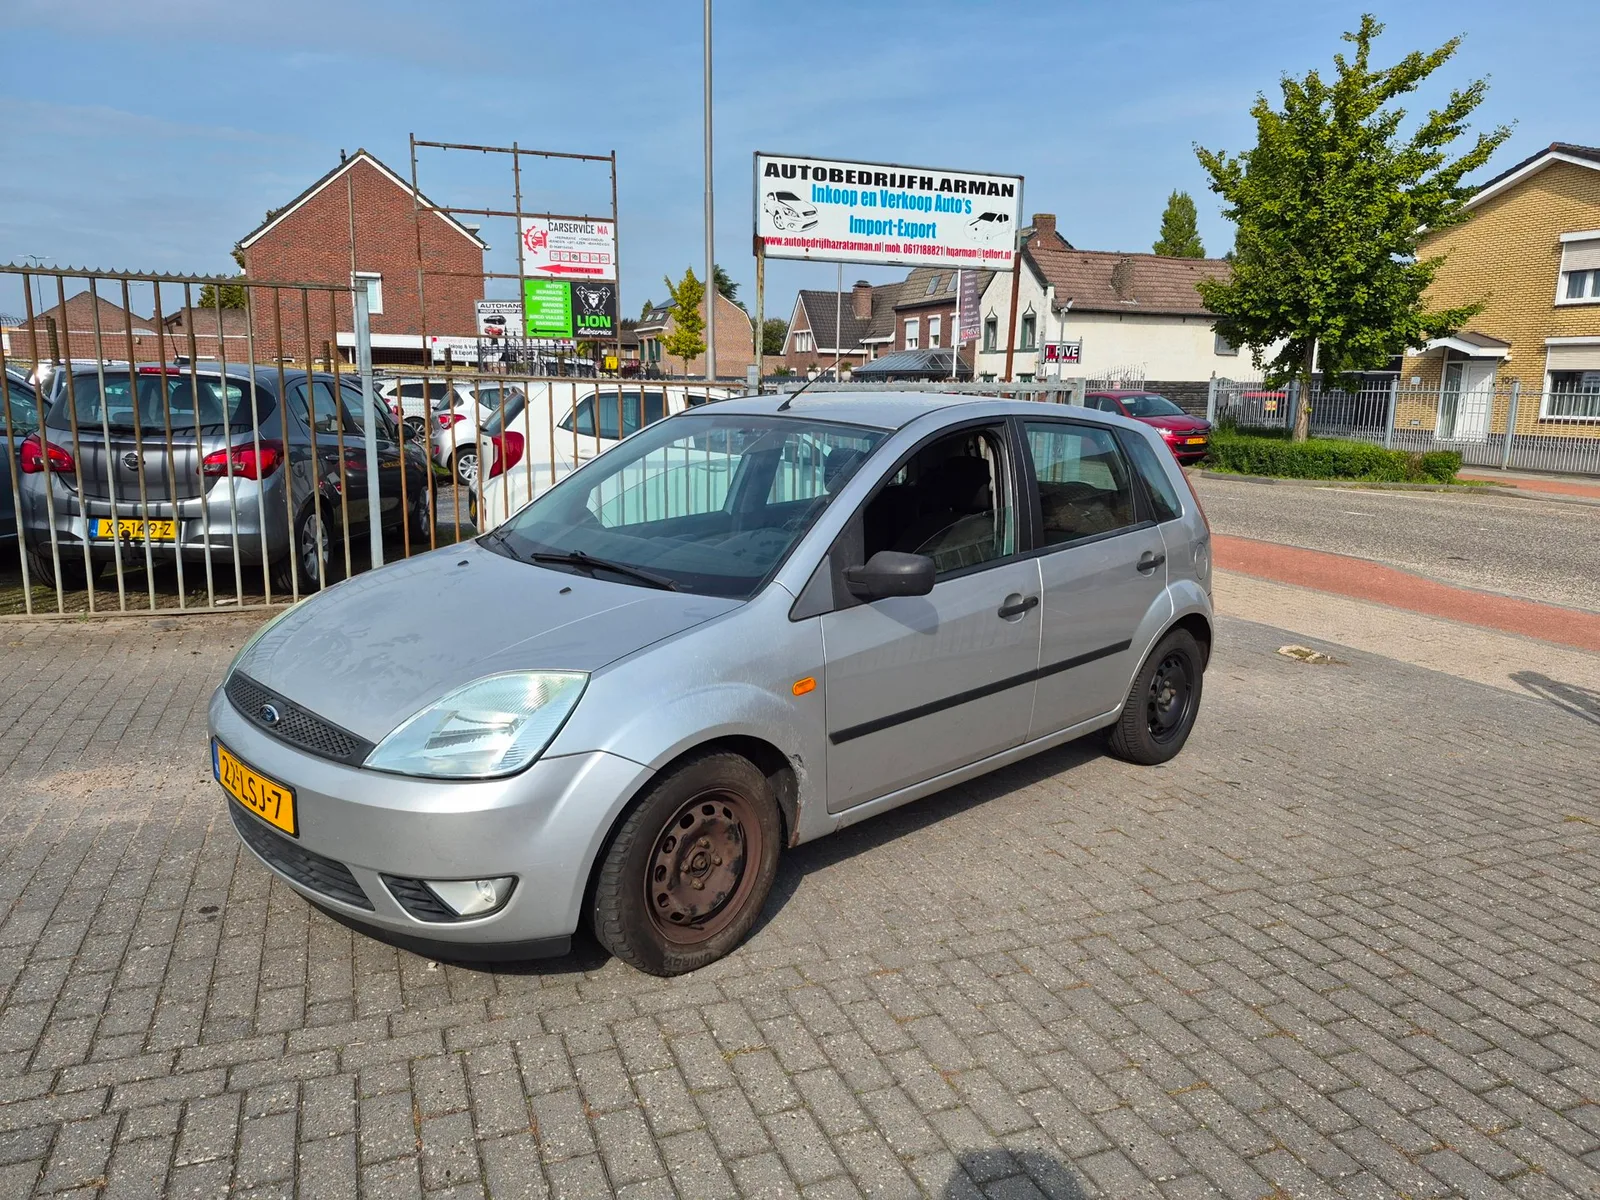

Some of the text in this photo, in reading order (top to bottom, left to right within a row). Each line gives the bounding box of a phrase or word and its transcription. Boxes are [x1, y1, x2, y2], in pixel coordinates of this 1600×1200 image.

[764, 163, 1014, 198] AUTOBEDRIJFH.ARMAN
[812, 184, 972, 214] Inkoop en Verkoop Auto's
[548, 222, 608, 235] CARSERVICE MA
[849, 215, 937, 239] Import-Export
[577, 315, 611, 327] LION
[222, 755, 281, 819] 22-LSJ-7
